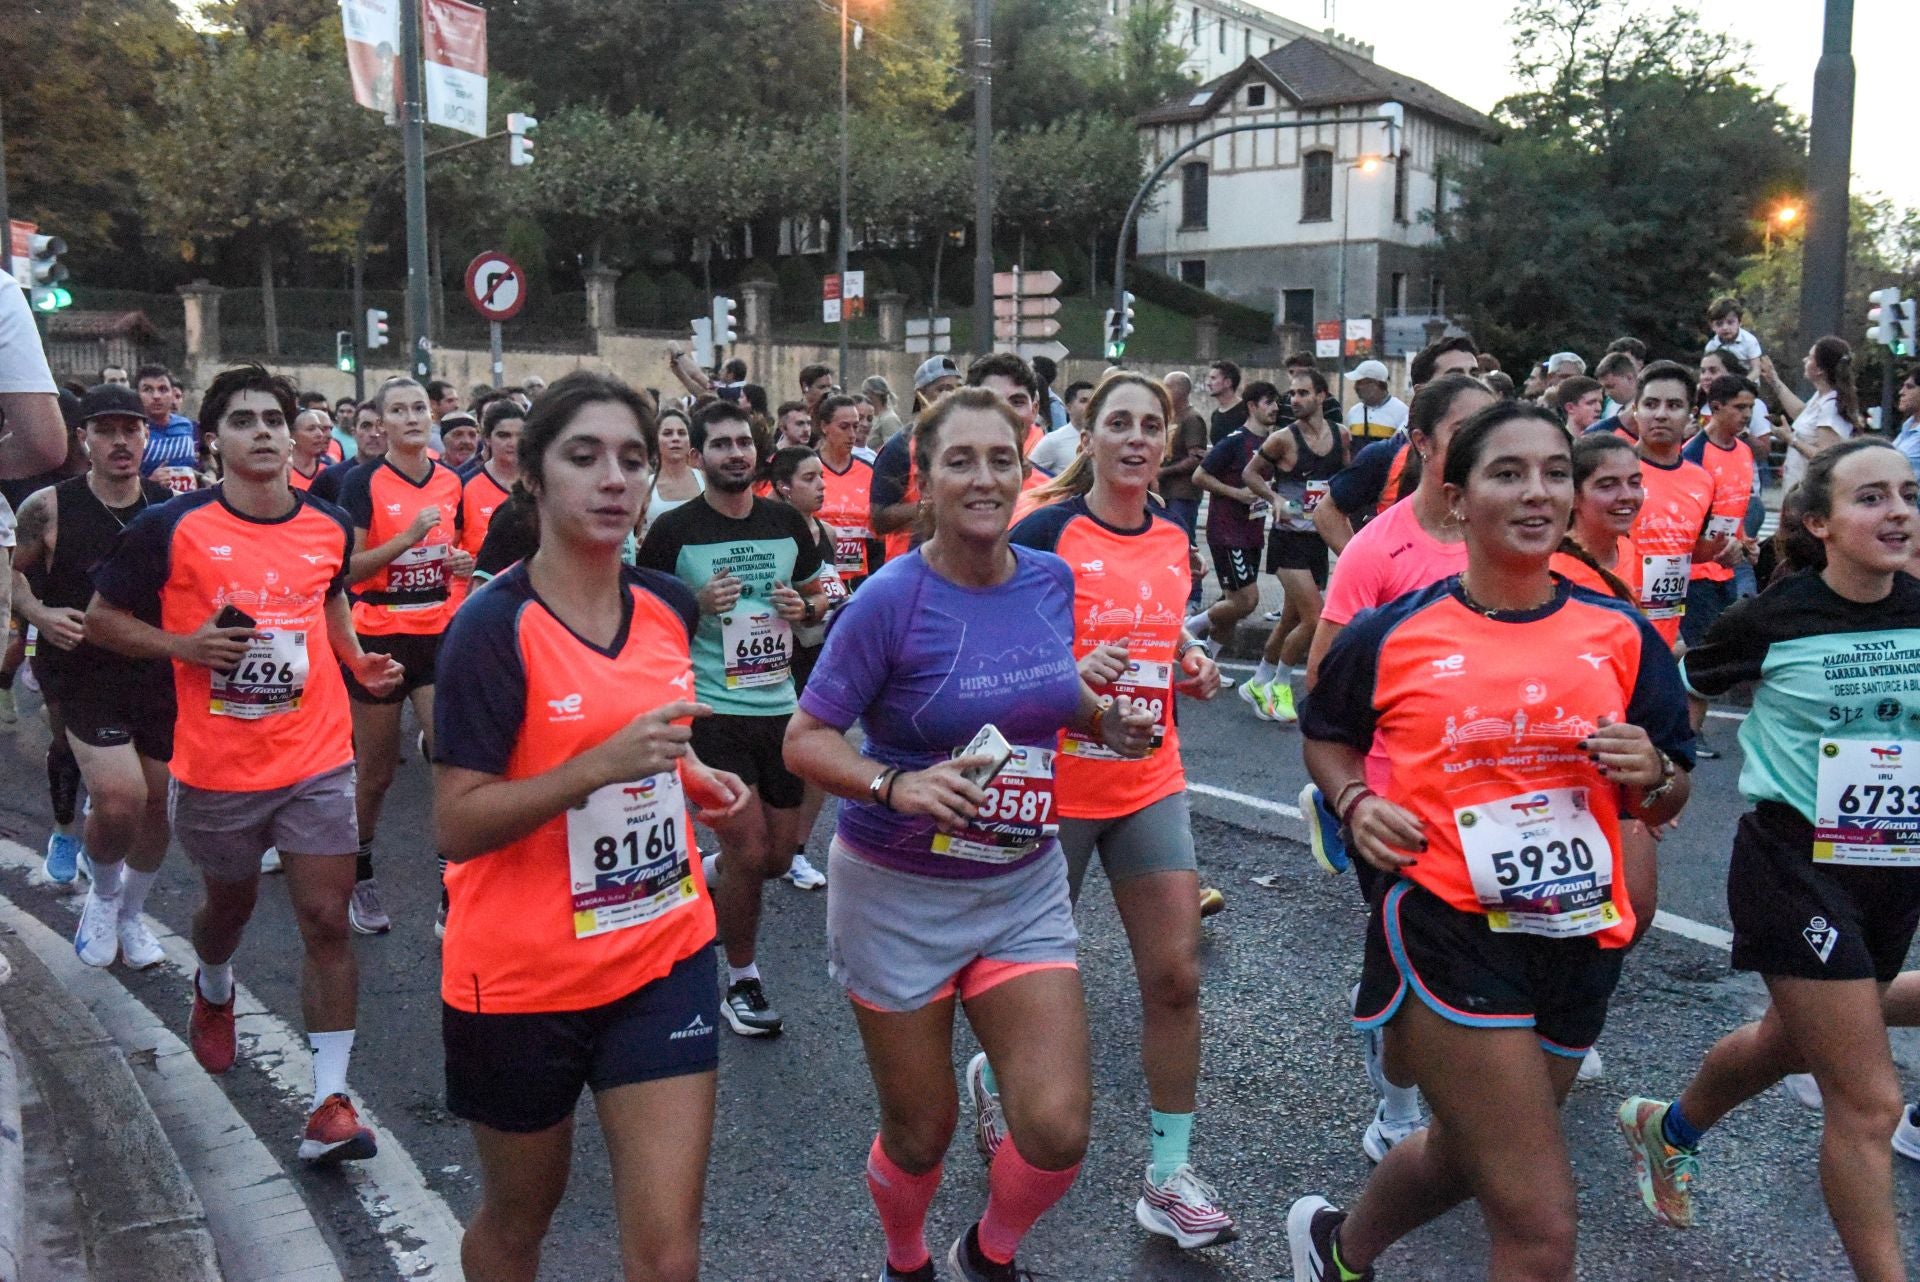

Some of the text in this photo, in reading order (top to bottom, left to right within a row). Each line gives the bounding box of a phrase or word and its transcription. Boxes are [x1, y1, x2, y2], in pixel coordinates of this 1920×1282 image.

[729, 546, 754, 555] XXXVI
[391, 565, 444, 587] 23534
[1652, 576, 1686, 594] 4330
[736, 633, 786, 658] 6684
[1853, 640, 1896, 651] XXXVI
[1823, 652, 1883, 667] NAZIOARTEKO
[959, 675, 999, 691] HIRU
[1001, 657, 1073, 685] HAUNDIAK
[1824, 666, 1868, 680] CARRERA
[1115, 685, 1136, 693] LEIRE
[1862, 680, 1901, 694] SANTURCE
[1903, 680, 1909, 691] A
[1497, 755, 1534, 767] NIGHT
[1002, 777, 1025, 786] EMMA
[1878, 773, 1894, 781] IRU
[978, 787, 1052, 823] 3587
[1838, 784, 1920, 815] 6733
[626, 812, 656, 826] PAULA
[593, 817, 676, 872] 8160
[1491, 837, 1594, 887] 5930
[685, 883, 693, 894] 6
[576, 896, 607, 908] LABORAL
[1605, 908, 1614, 920] 5
